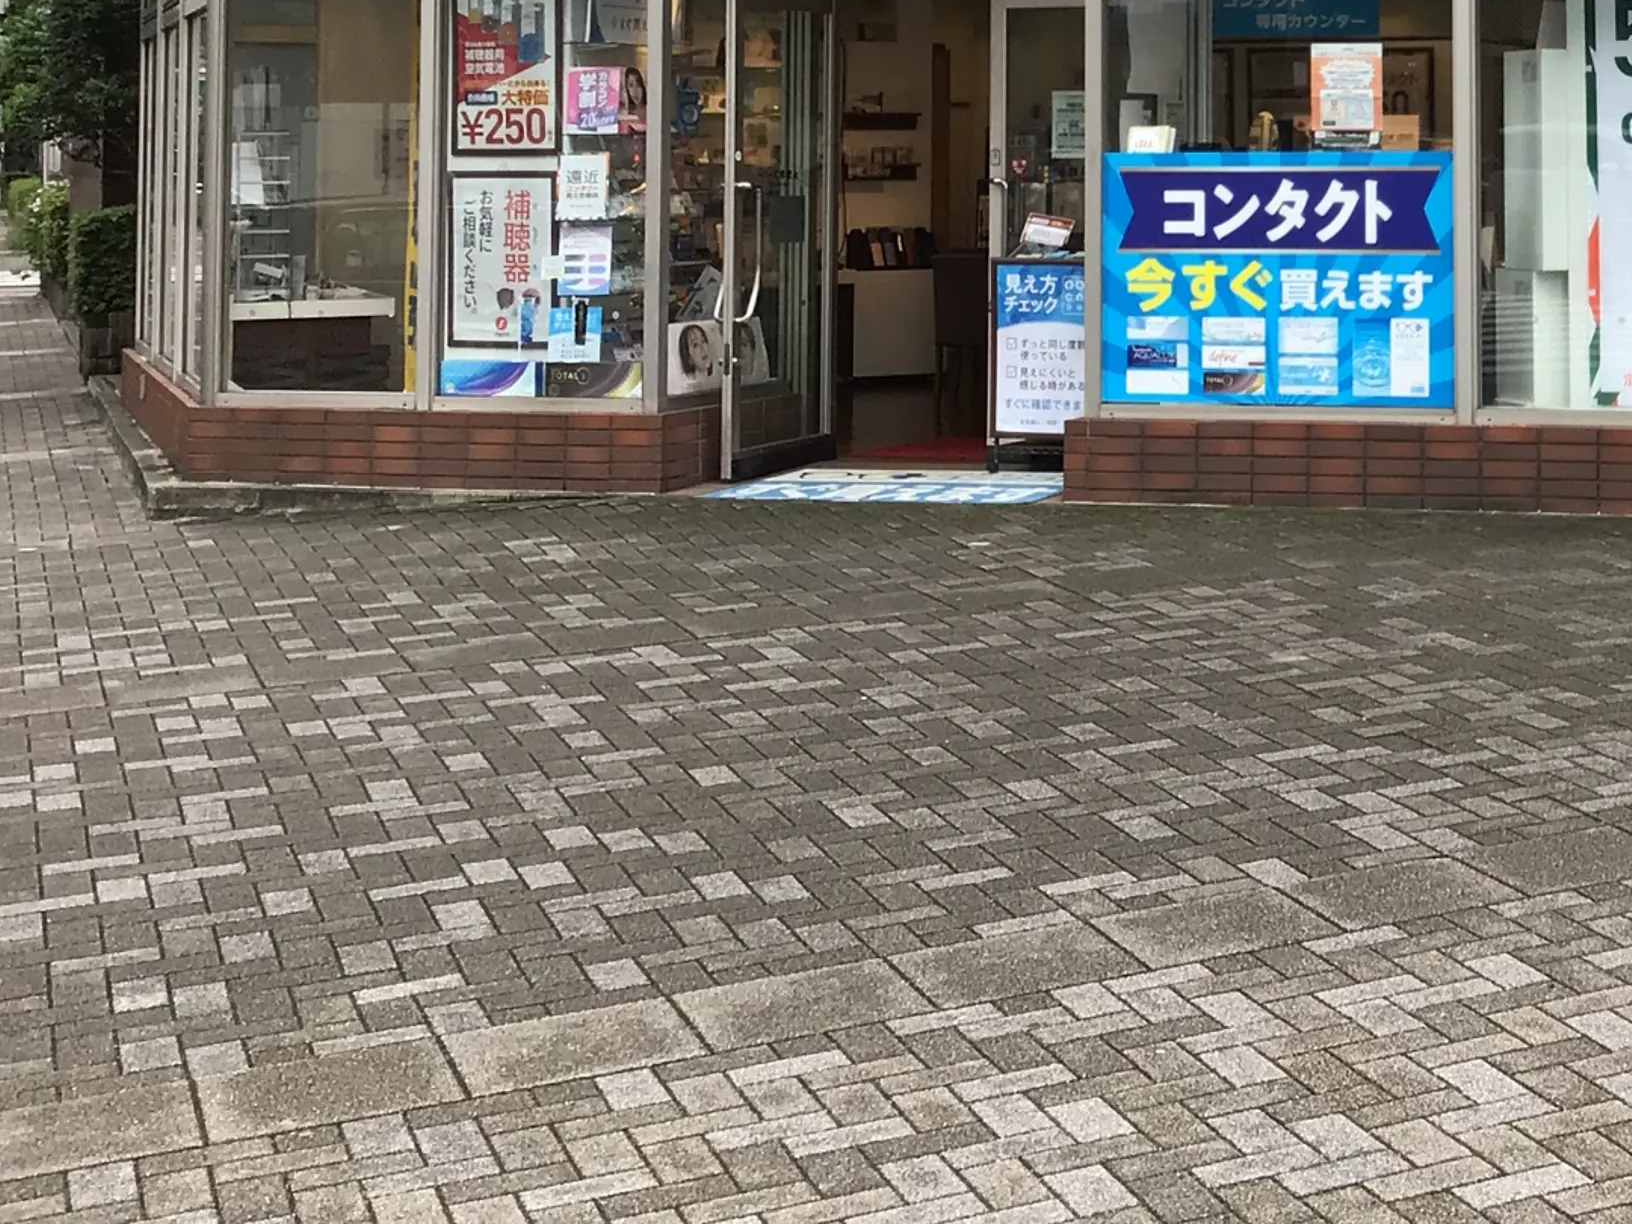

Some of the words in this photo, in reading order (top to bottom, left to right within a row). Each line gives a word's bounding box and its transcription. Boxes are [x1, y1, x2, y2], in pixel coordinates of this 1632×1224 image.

[1255, 13, 1367, 31] 専用カウンター
[501, 90, 549, 105] 大特価
[460, 108, 547, 146] ¥250
[479, 189, 494, 253] お気軽に
[1163, 178, 1393, 245] コンタクト
[503, 189, 531, 284] 補聴器
[1005, 273, 1059, 295] 見え方
[1003, 295, 1058, 315] チェック
